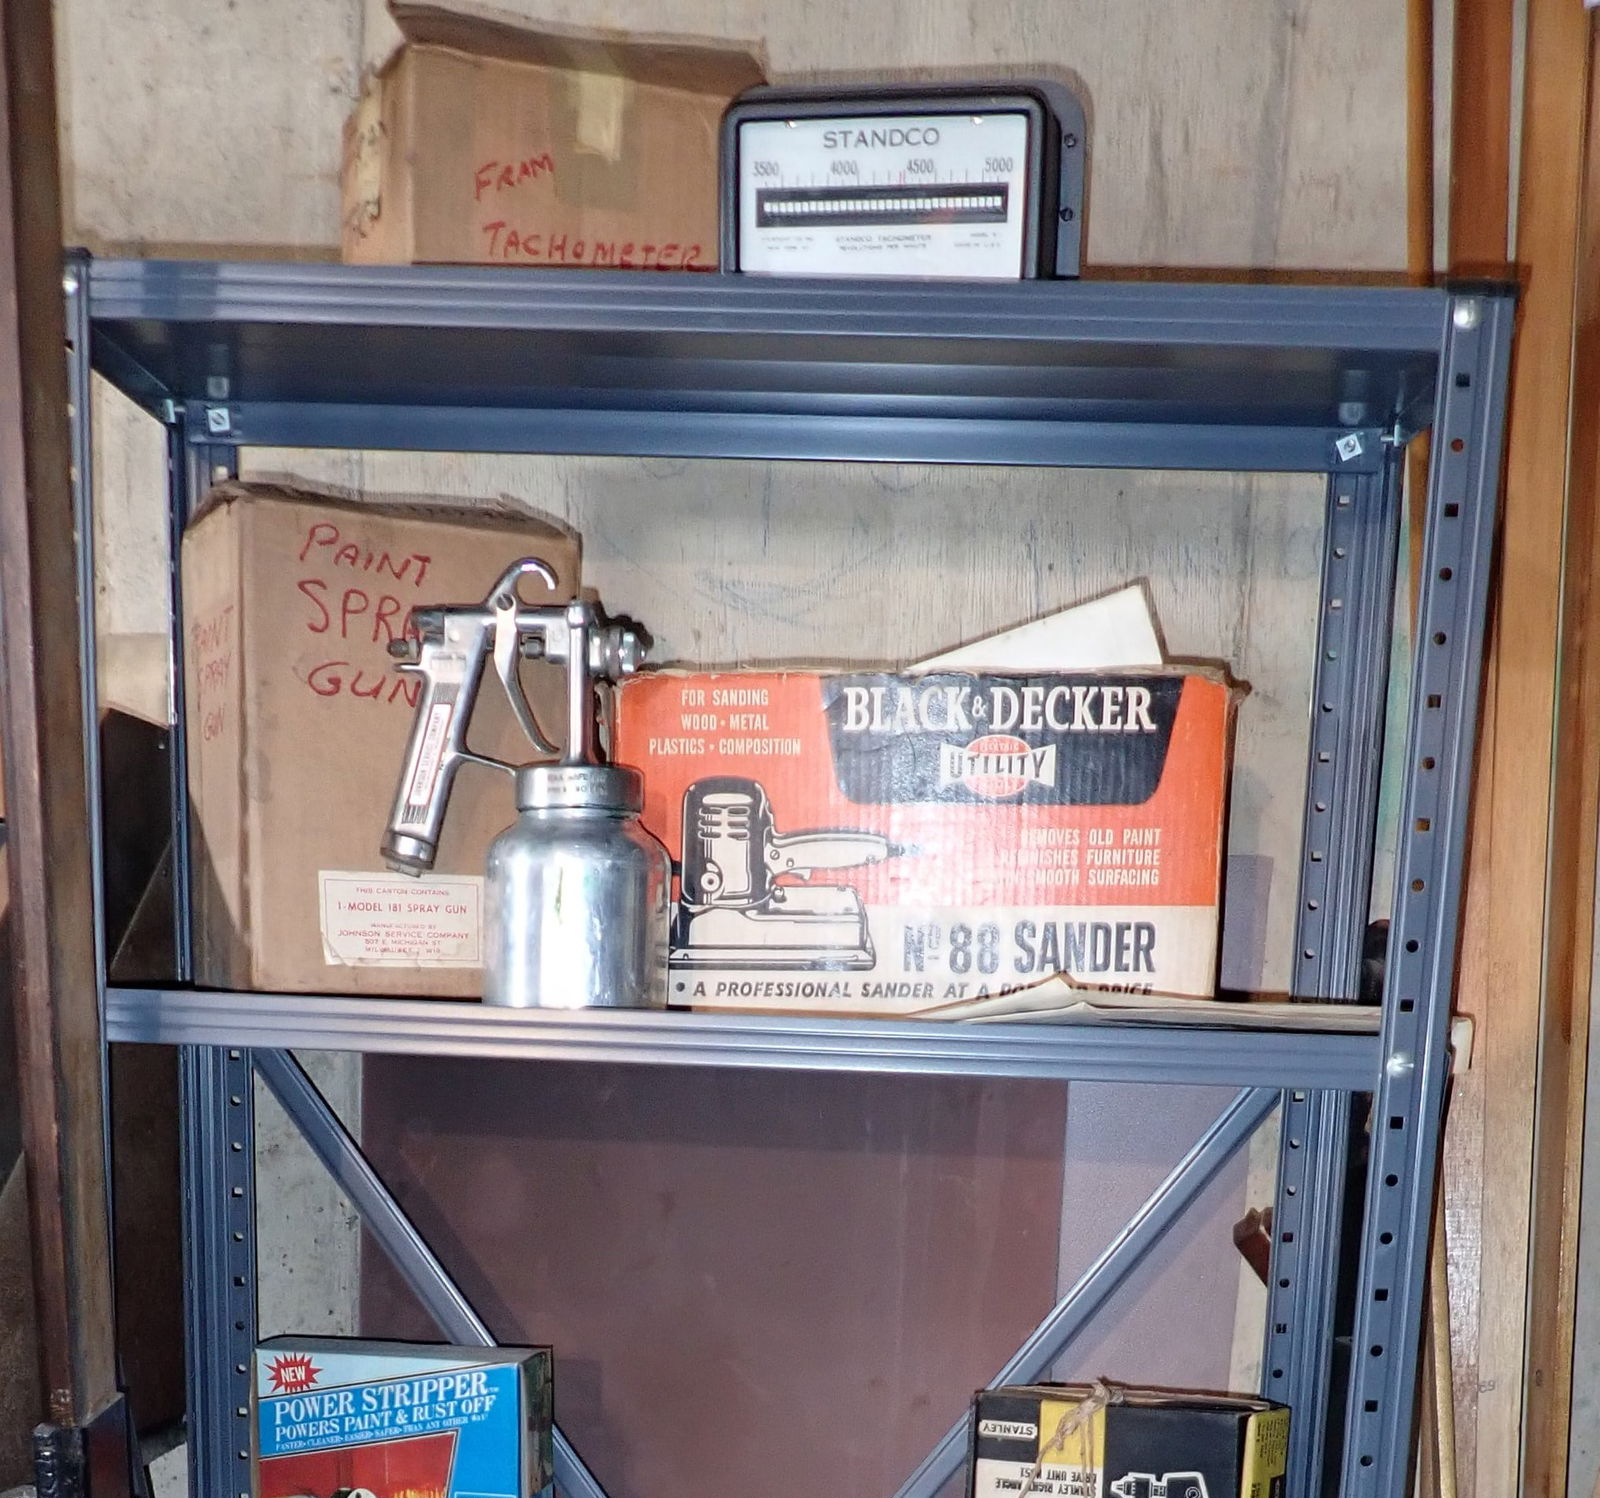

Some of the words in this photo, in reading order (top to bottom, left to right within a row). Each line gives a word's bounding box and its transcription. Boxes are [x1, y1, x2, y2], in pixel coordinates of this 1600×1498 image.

[823, 127, 940, 149] STANDCO
[752, 161, 780, 177] 3500
[830, 160, 858, 176] 4000
[906, 158, 935, 175] 4500
[984, 157, 1014, 173] 5000
[474, 152, 555, 202] FRAM
[482, 220, 703, 268] TACHOMETER
[300, 522, 431, 587] PAINT
[298, 579, 421, 643] SPRA
[308, 661, 422, 708] GUN
[681, 689, 705, 706] FOR
[712, 689, 769, 707] SANDING
[843, 686, 973, 731] BLACK
[971, 695, 986, 719] &
[988, 686, 1157, 731] DECKER
[681, 714, 717, 731] WOOD
[729, 714, 769, 730] METAL
[649, 738, 705, 755] PLASTICS
[718, 738, 801, 755] COMPOSITION
[950, 750, 1047, 780] UTILITY
[1089, 828, 1114, 846] OLD
[1123, 828, 1162, 845] PAINT
[1087, 849, 1160, 866] FURNITURE
[1088, 868, 1159, 886] SURFACING
[388, 904, 402, 912] 181
[407, 903, 440, 913] SPRAY
[445, 904, 467, 915] GUN
[338, 929, 380, 938] JOHNSON
[385, 931, 422, 939] SERVICE
[427, 931, 469, 940] COMPANY
[949, 921, 999, 975] 88
[1014, 920, 1156, 975] SANDER
[693, 982, 706, 997] A
[716, 982, 852, 998] PROFESSIONAL
[861, 982, 934, 999] SANDER
[943, 983, 967, 999] AT
[977, 983, 990, 999] A
[280, 1365, 306, 1383] NEW
[274, 1390, 355, 1425] POWER
[361, 1371, 488, 1412] STRIPPER
[276, 1417, 340, 1442] POWERS
[344, 1410, 392, 1429] PAINT
[396, 1411, 409, 1424] &
[412, 1400, 456, 1421] RUST
[461, 1395, 497, 1413] OFF
[426, 1421, 440, 1430] ANY
[442, 1416, 468, 1426] OTHER
[983, 1423, 1035, 1436] STANLEY
[1046, 1468, 1067, 1481] UNIT
